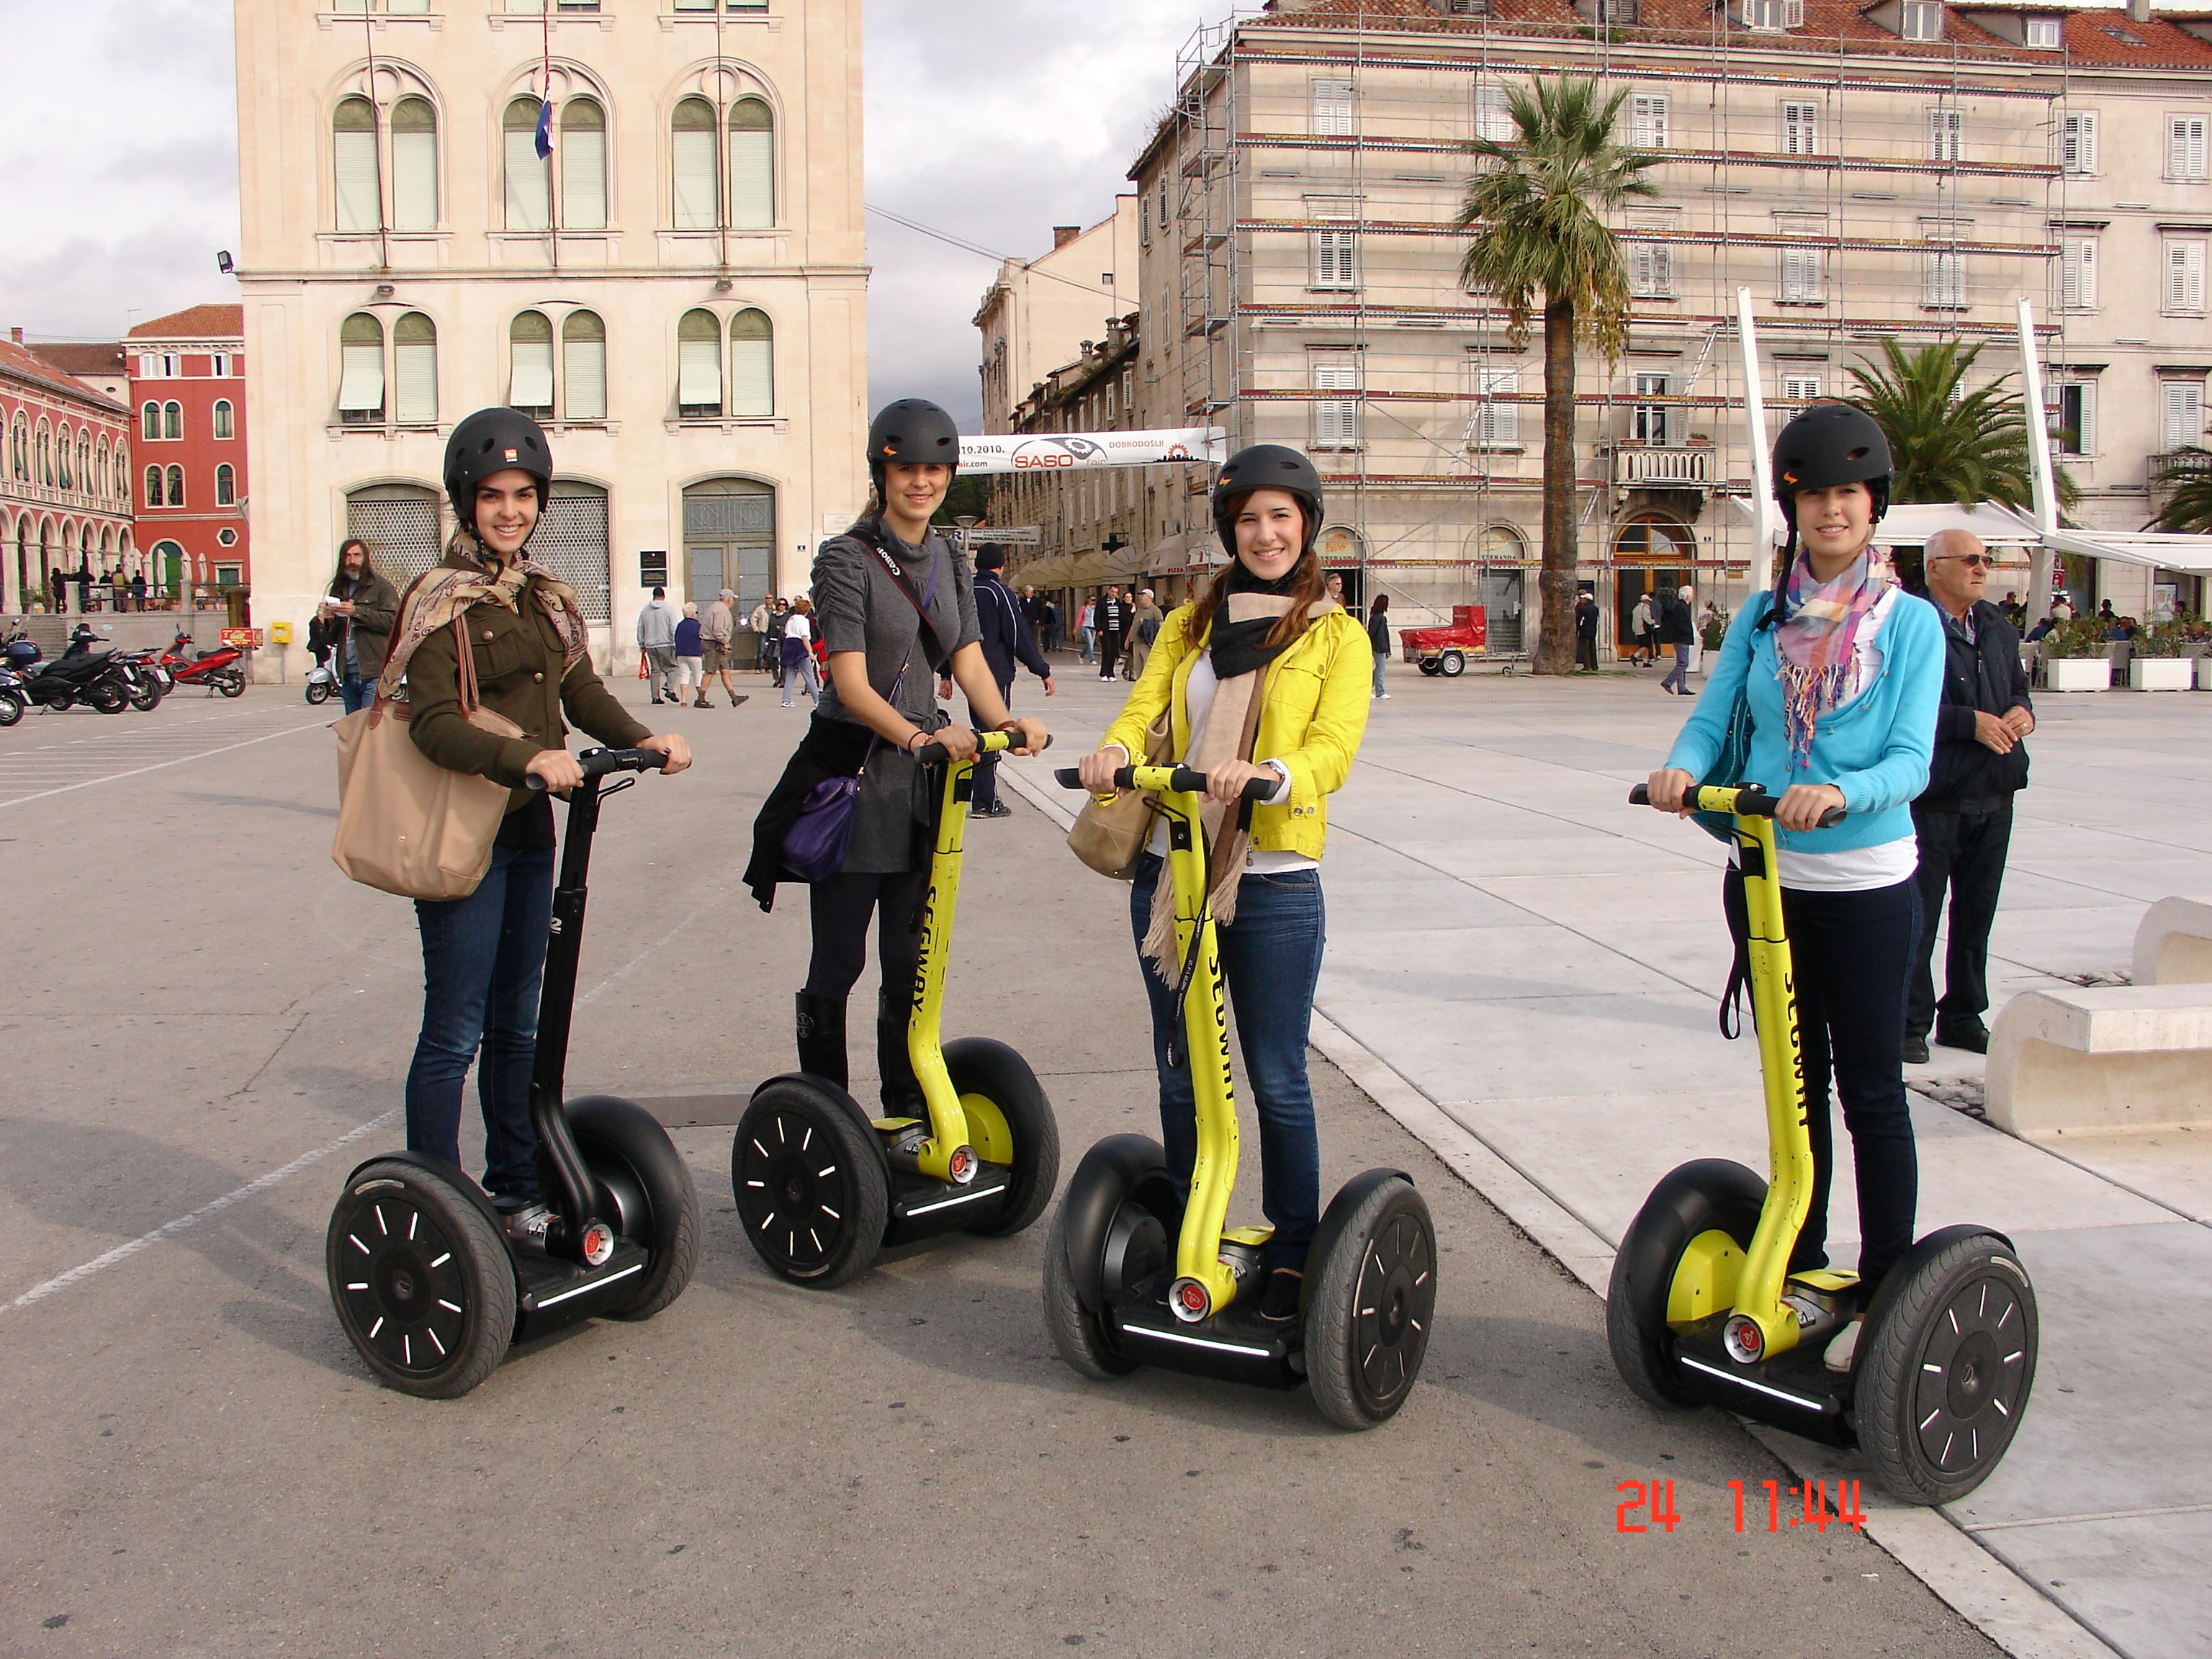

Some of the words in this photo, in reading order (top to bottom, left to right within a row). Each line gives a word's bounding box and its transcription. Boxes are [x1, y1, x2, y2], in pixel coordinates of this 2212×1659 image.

[1015, 455, 1073, 468] SASO
[876, 547, 900, 576] Canon
[913, 886, 936, 1012] SEGWAY
